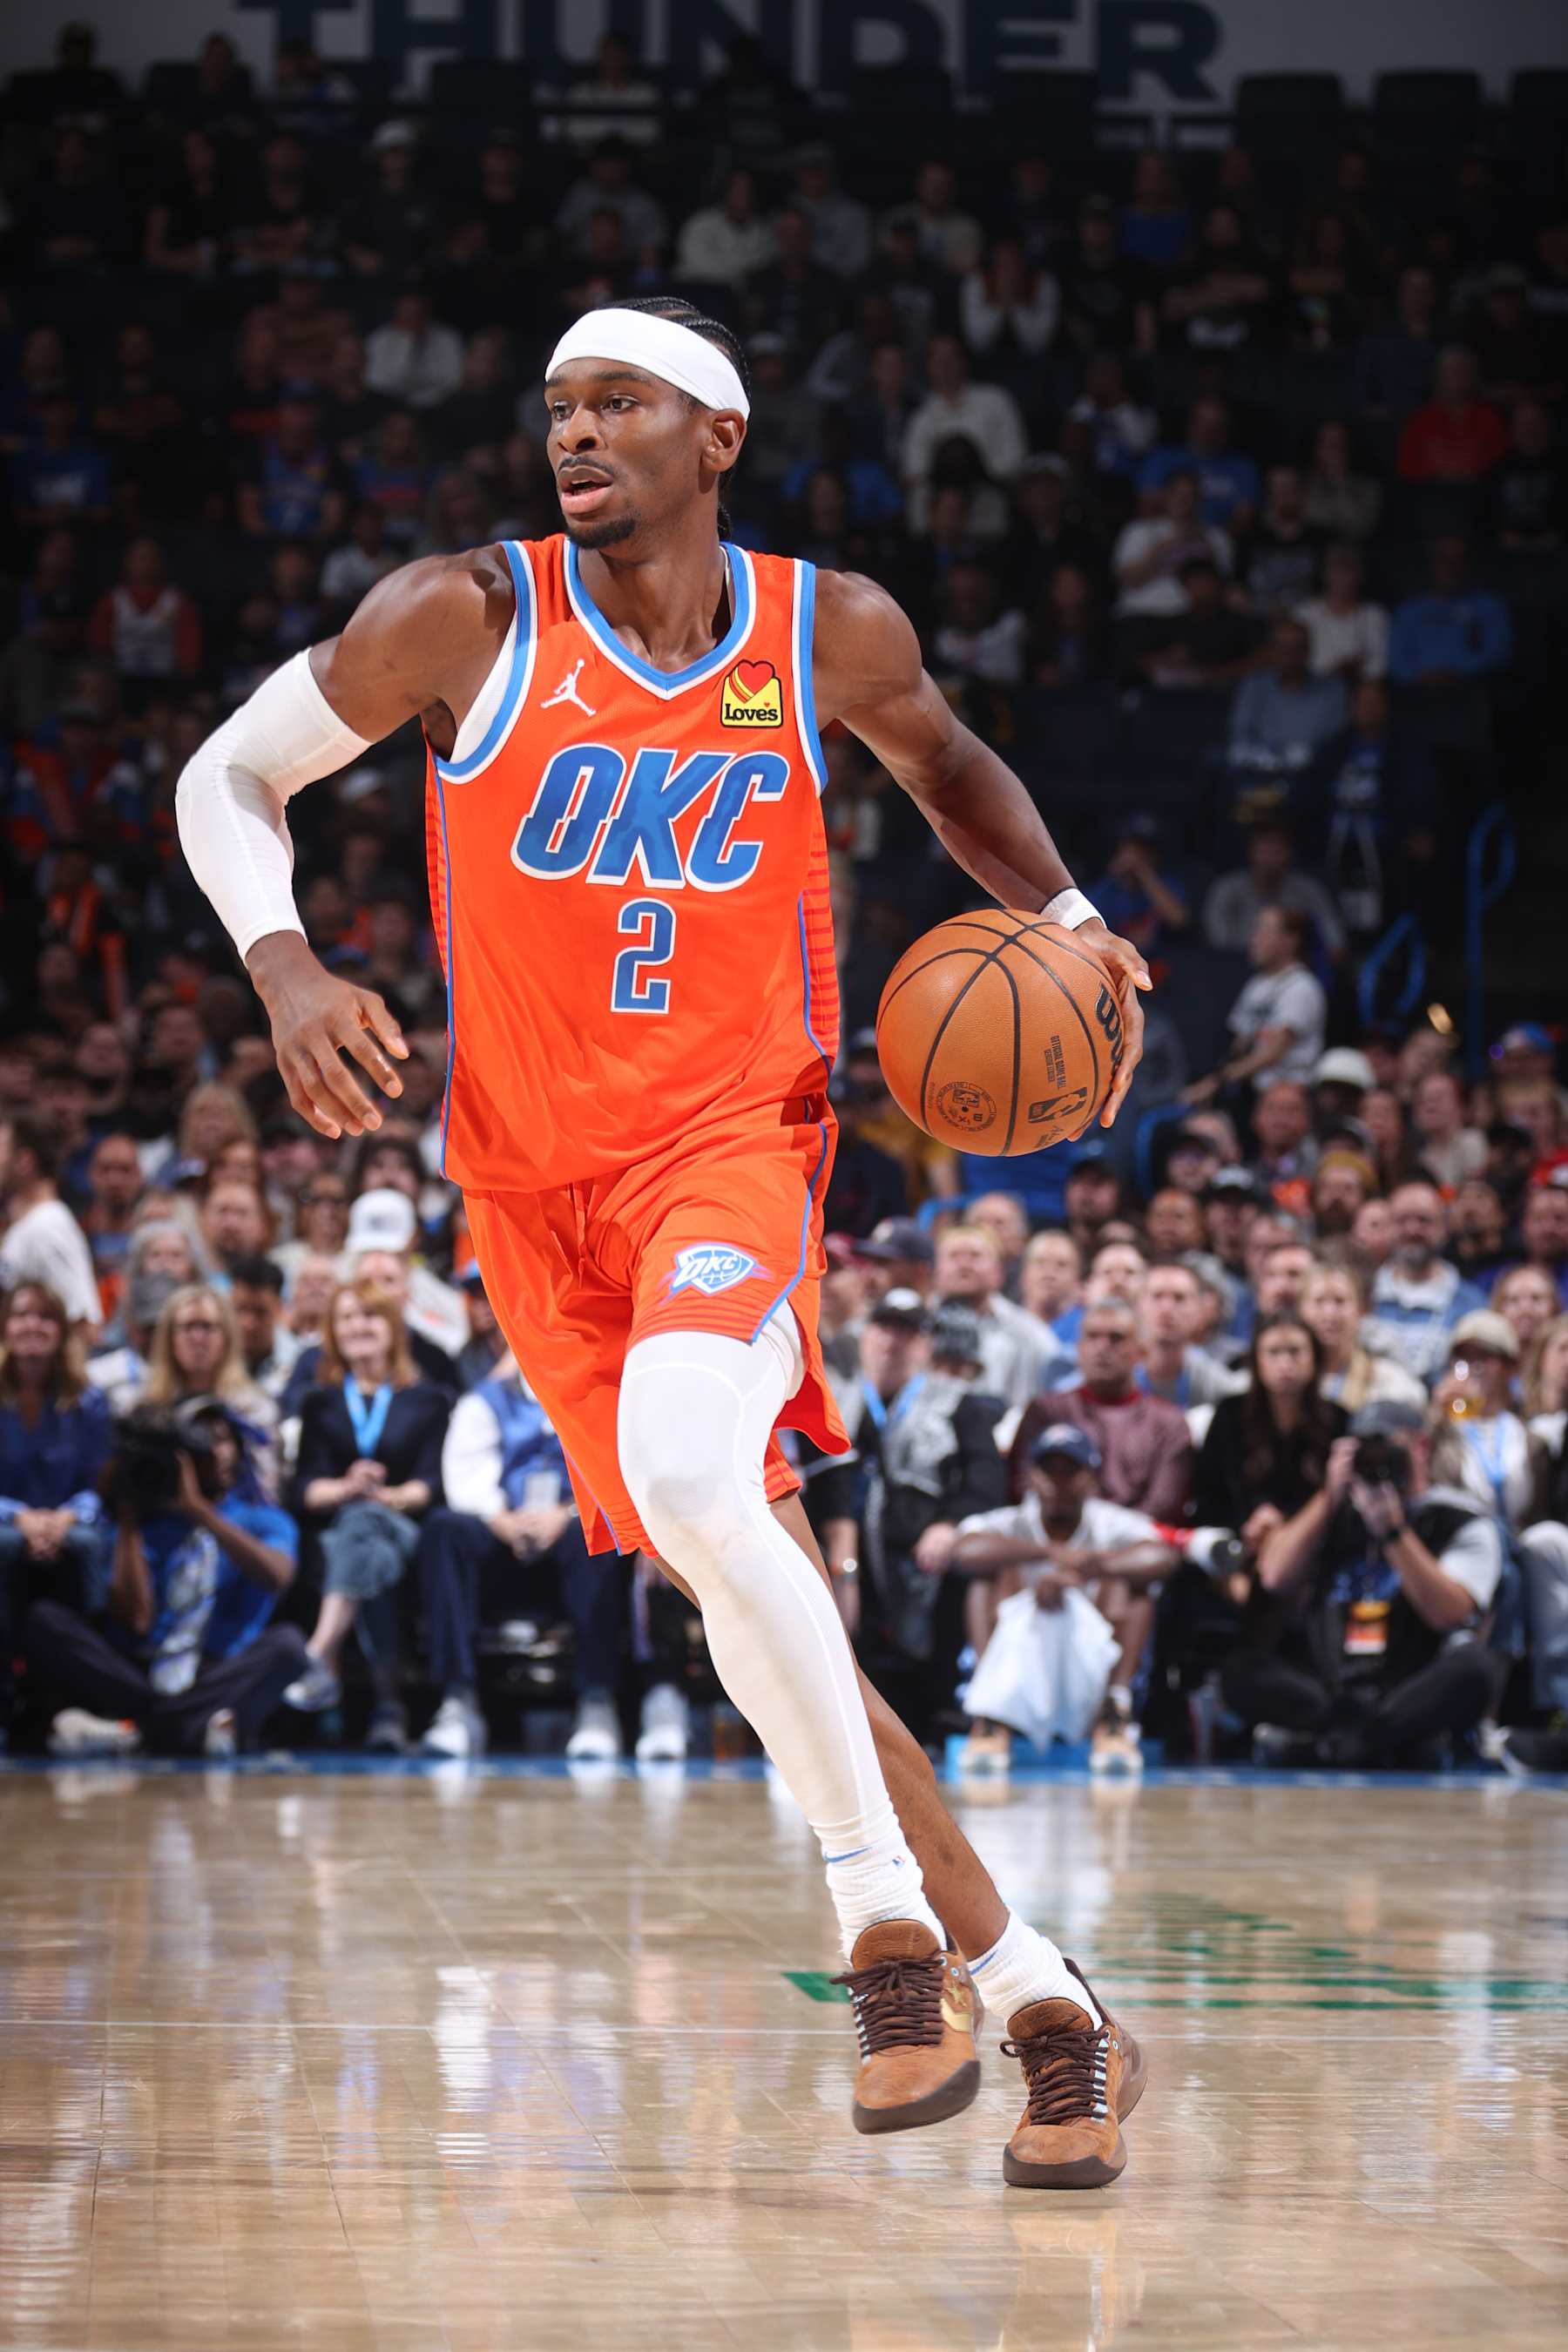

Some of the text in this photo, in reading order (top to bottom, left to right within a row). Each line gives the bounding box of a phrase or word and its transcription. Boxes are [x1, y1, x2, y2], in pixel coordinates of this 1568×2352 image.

[238, 0, 1222, 102] THUNDER
[510, 743, 791, 892] OKC
[611, 897, 677, 1014] 2
[672, 1257, 738, 1288] OKC
